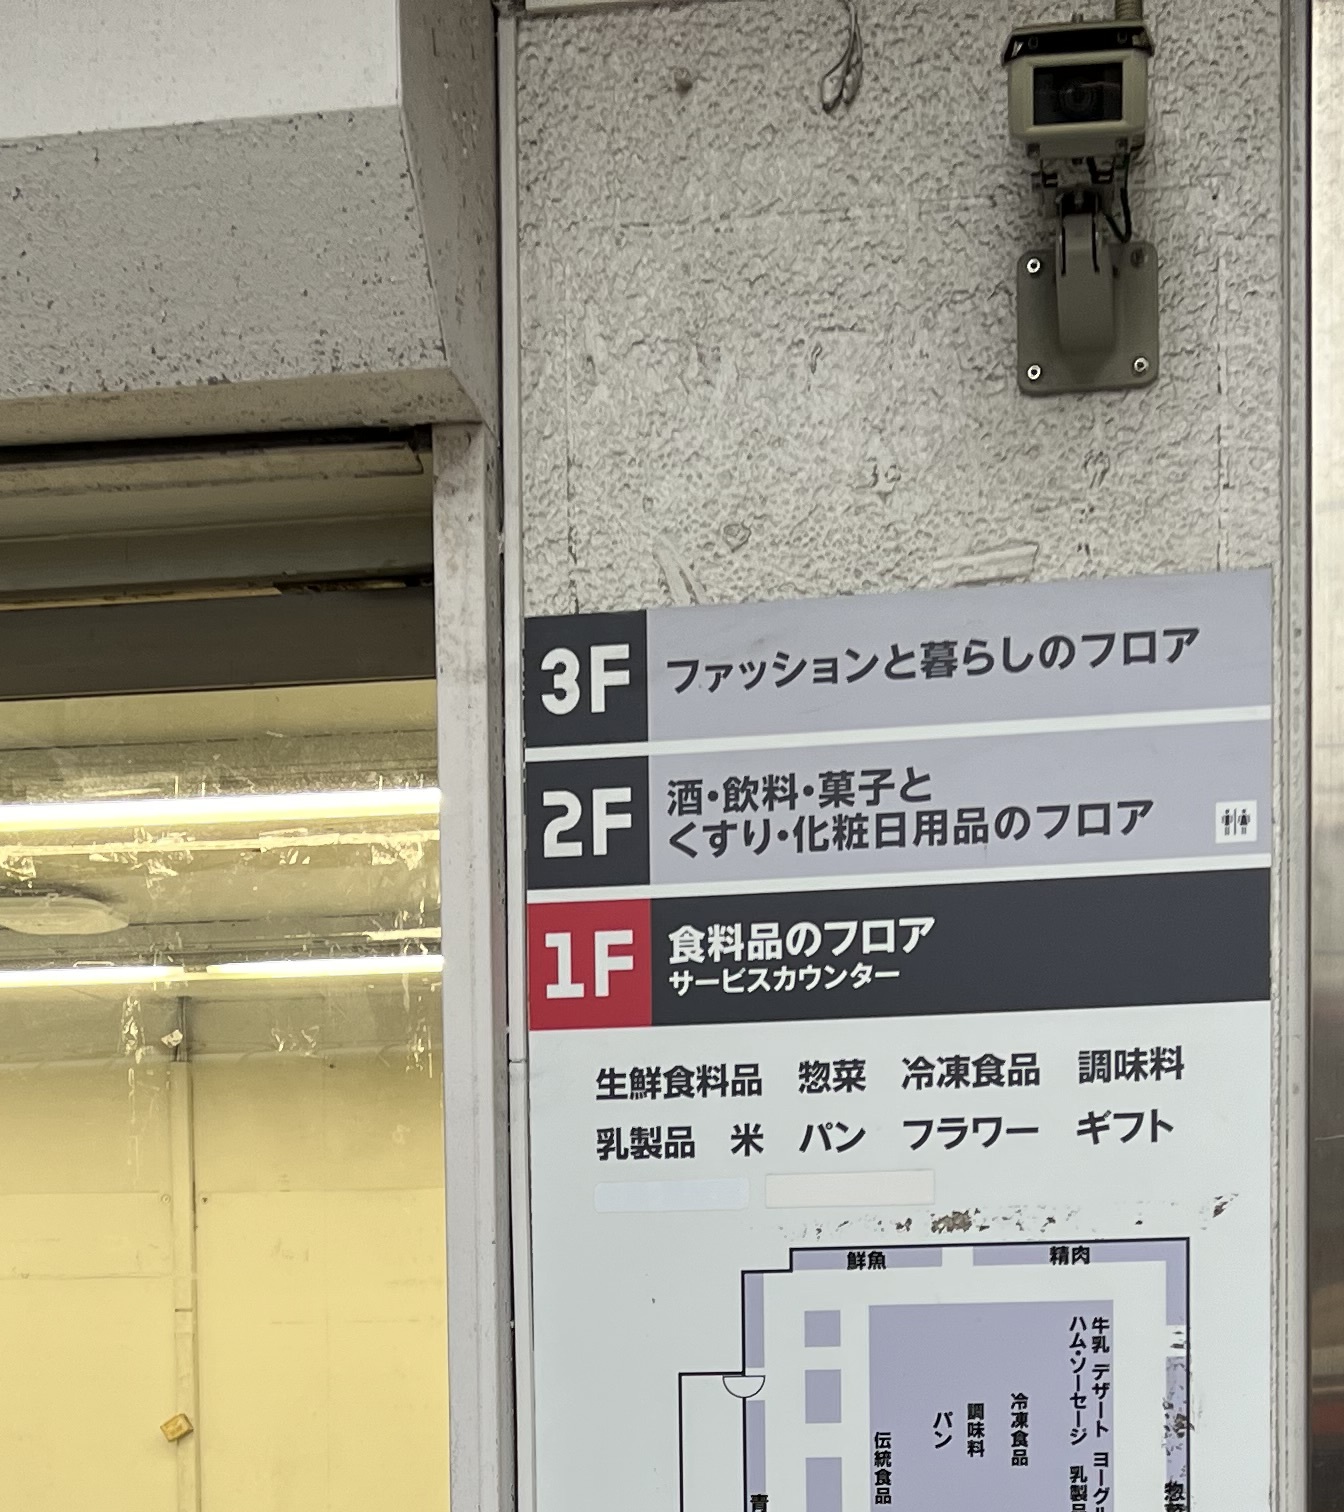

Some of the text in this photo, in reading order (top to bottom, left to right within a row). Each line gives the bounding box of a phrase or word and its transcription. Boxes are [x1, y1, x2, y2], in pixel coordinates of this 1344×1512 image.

[540, 643, 631, 715] 3F
[665, 625, 1202, 695] ファッションと暮らしのフロア
[666, 765, 933, 817] 酒・飲料・菓子と
[541, 788, 633, 858] 2F
[667, 799, 1155, 860] くすり・化粧日用品のフロア
[544, 929, 635, 999] 1F
[667, 916, 936, 964] 食料品のフロア
[668, 964, 901, 997] サービスカウンター
[595, 1046, 1185, 1101] 生鮮食料品 惣菜 冷凍食品 調味料
[595, 1109, 1175, 1162] 乳製品 米 パン フラワー ギフト
[846, 1251, 887, 1271] 鮮魚
[1049, 1245, 1092, 1266] 精肉
[1091, 1316, 1110, 1354] 牛乳
[1069, 1316, 1088, 1446] ハム・ソーセージ
[1091, 1363, 1110, 1438] デザート
[933, 1411, 954, 1449] パン
[966, 1402, 985, 1459] 調味料
[1010, 1392, 1029, 1467] 冷凍食品
[873, 1431, 893, 1505] 伝統食品
